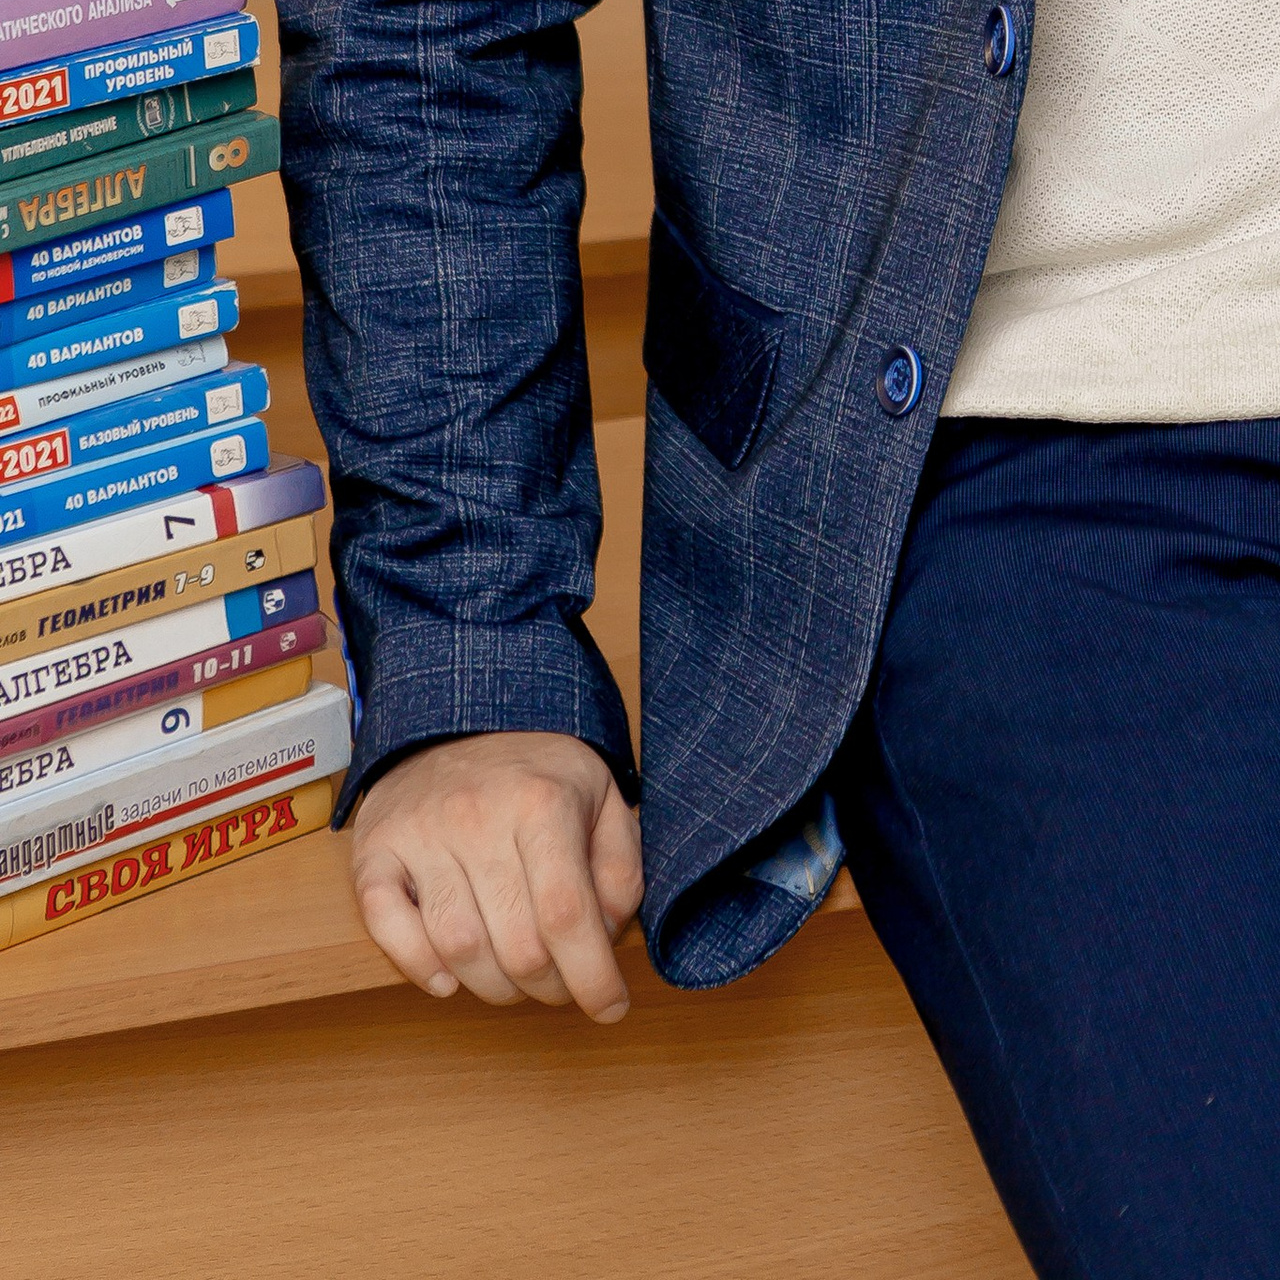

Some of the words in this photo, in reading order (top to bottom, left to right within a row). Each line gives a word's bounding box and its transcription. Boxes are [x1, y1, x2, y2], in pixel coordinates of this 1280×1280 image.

[84, 38, 193, 80] ПРОФИЛЬНЫЙ
[106, 64, 175, 93] УРОВЕНЬ
[0, 75, 64, 115] 2021
[69, 116, 118, 143] ИЗУЧЕНИЕ
[208, 136, 249, 172] 8
[18, 164, 147, 232] АЛГЕБРА
[31, 250, 49, 268] 40
[52, 225, 143, 262] ВАРИАНТОВ
[31, 270, 47, 284] ПО
[47, 259, 82, 279] НОВОЙ
[81, 245, 144, 271] ДЕМОВЕРСИИ
[26, 304, 44, 321] 40
[47, 278, 132, 316] ВАРИАНТОВ
[27, 352, 47, 370] 40
[50, 327, 145, 365] ВАРИАНТОВ
[38, 373, 117, 409] ПРОФИЛЬНЫЙ
[118, 360, 167, 386] УРОВЕНЬ
[79, 419, 142, 451] БАЗОВЫЙ
[143, 406, 199, 433] УРОВЕНЬ
[0, 436, 65, 479] 2021
[64, 493, 84, 512] 40
[87, 465, 179, 506] ВАРИАНТОВ
[163, 515, 195, 540] 7
[37, 579, 167, 638] ГЕОМЕТРИЯ
[174, 564, 215, 595] 7-9
[56, 670, 180, 730] ГЕОМЕТРИЯ
[191, 644, 253, 684] 10-11
[120, 785, 182, 825] задачи
[187, 774, 209, 796] по
[214, 738, 316, 787] математике
[45, 841, 171, 921] СВОЯ
[181, 796, 299, 871] ИГРА
